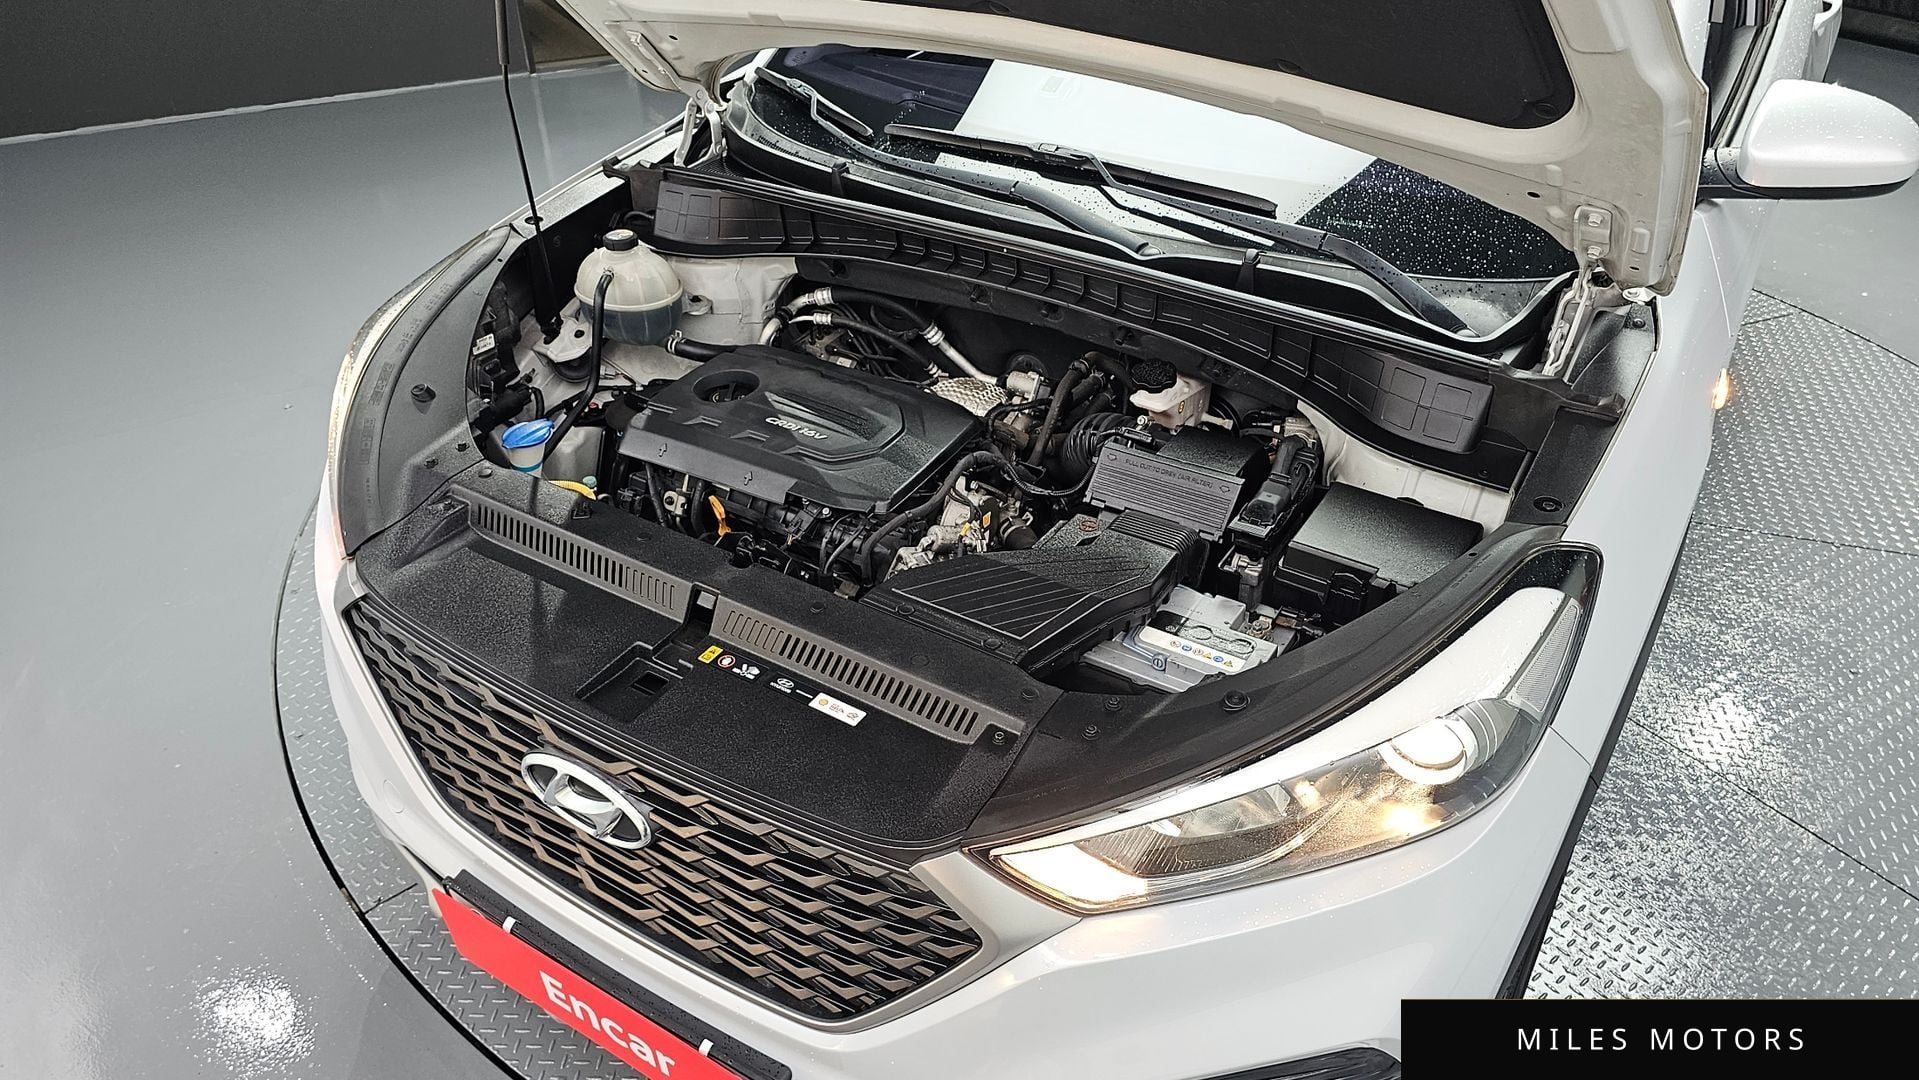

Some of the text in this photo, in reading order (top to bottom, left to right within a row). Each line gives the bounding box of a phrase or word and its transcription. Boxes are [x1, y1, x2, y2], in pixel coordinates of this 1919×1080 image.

[799, 428, 827, 438] 16V
[1125, 458, 1139, 467] PULL
[1140, 463, 1152, 471] OUT
[538, 970, 675, 1076] Encar
